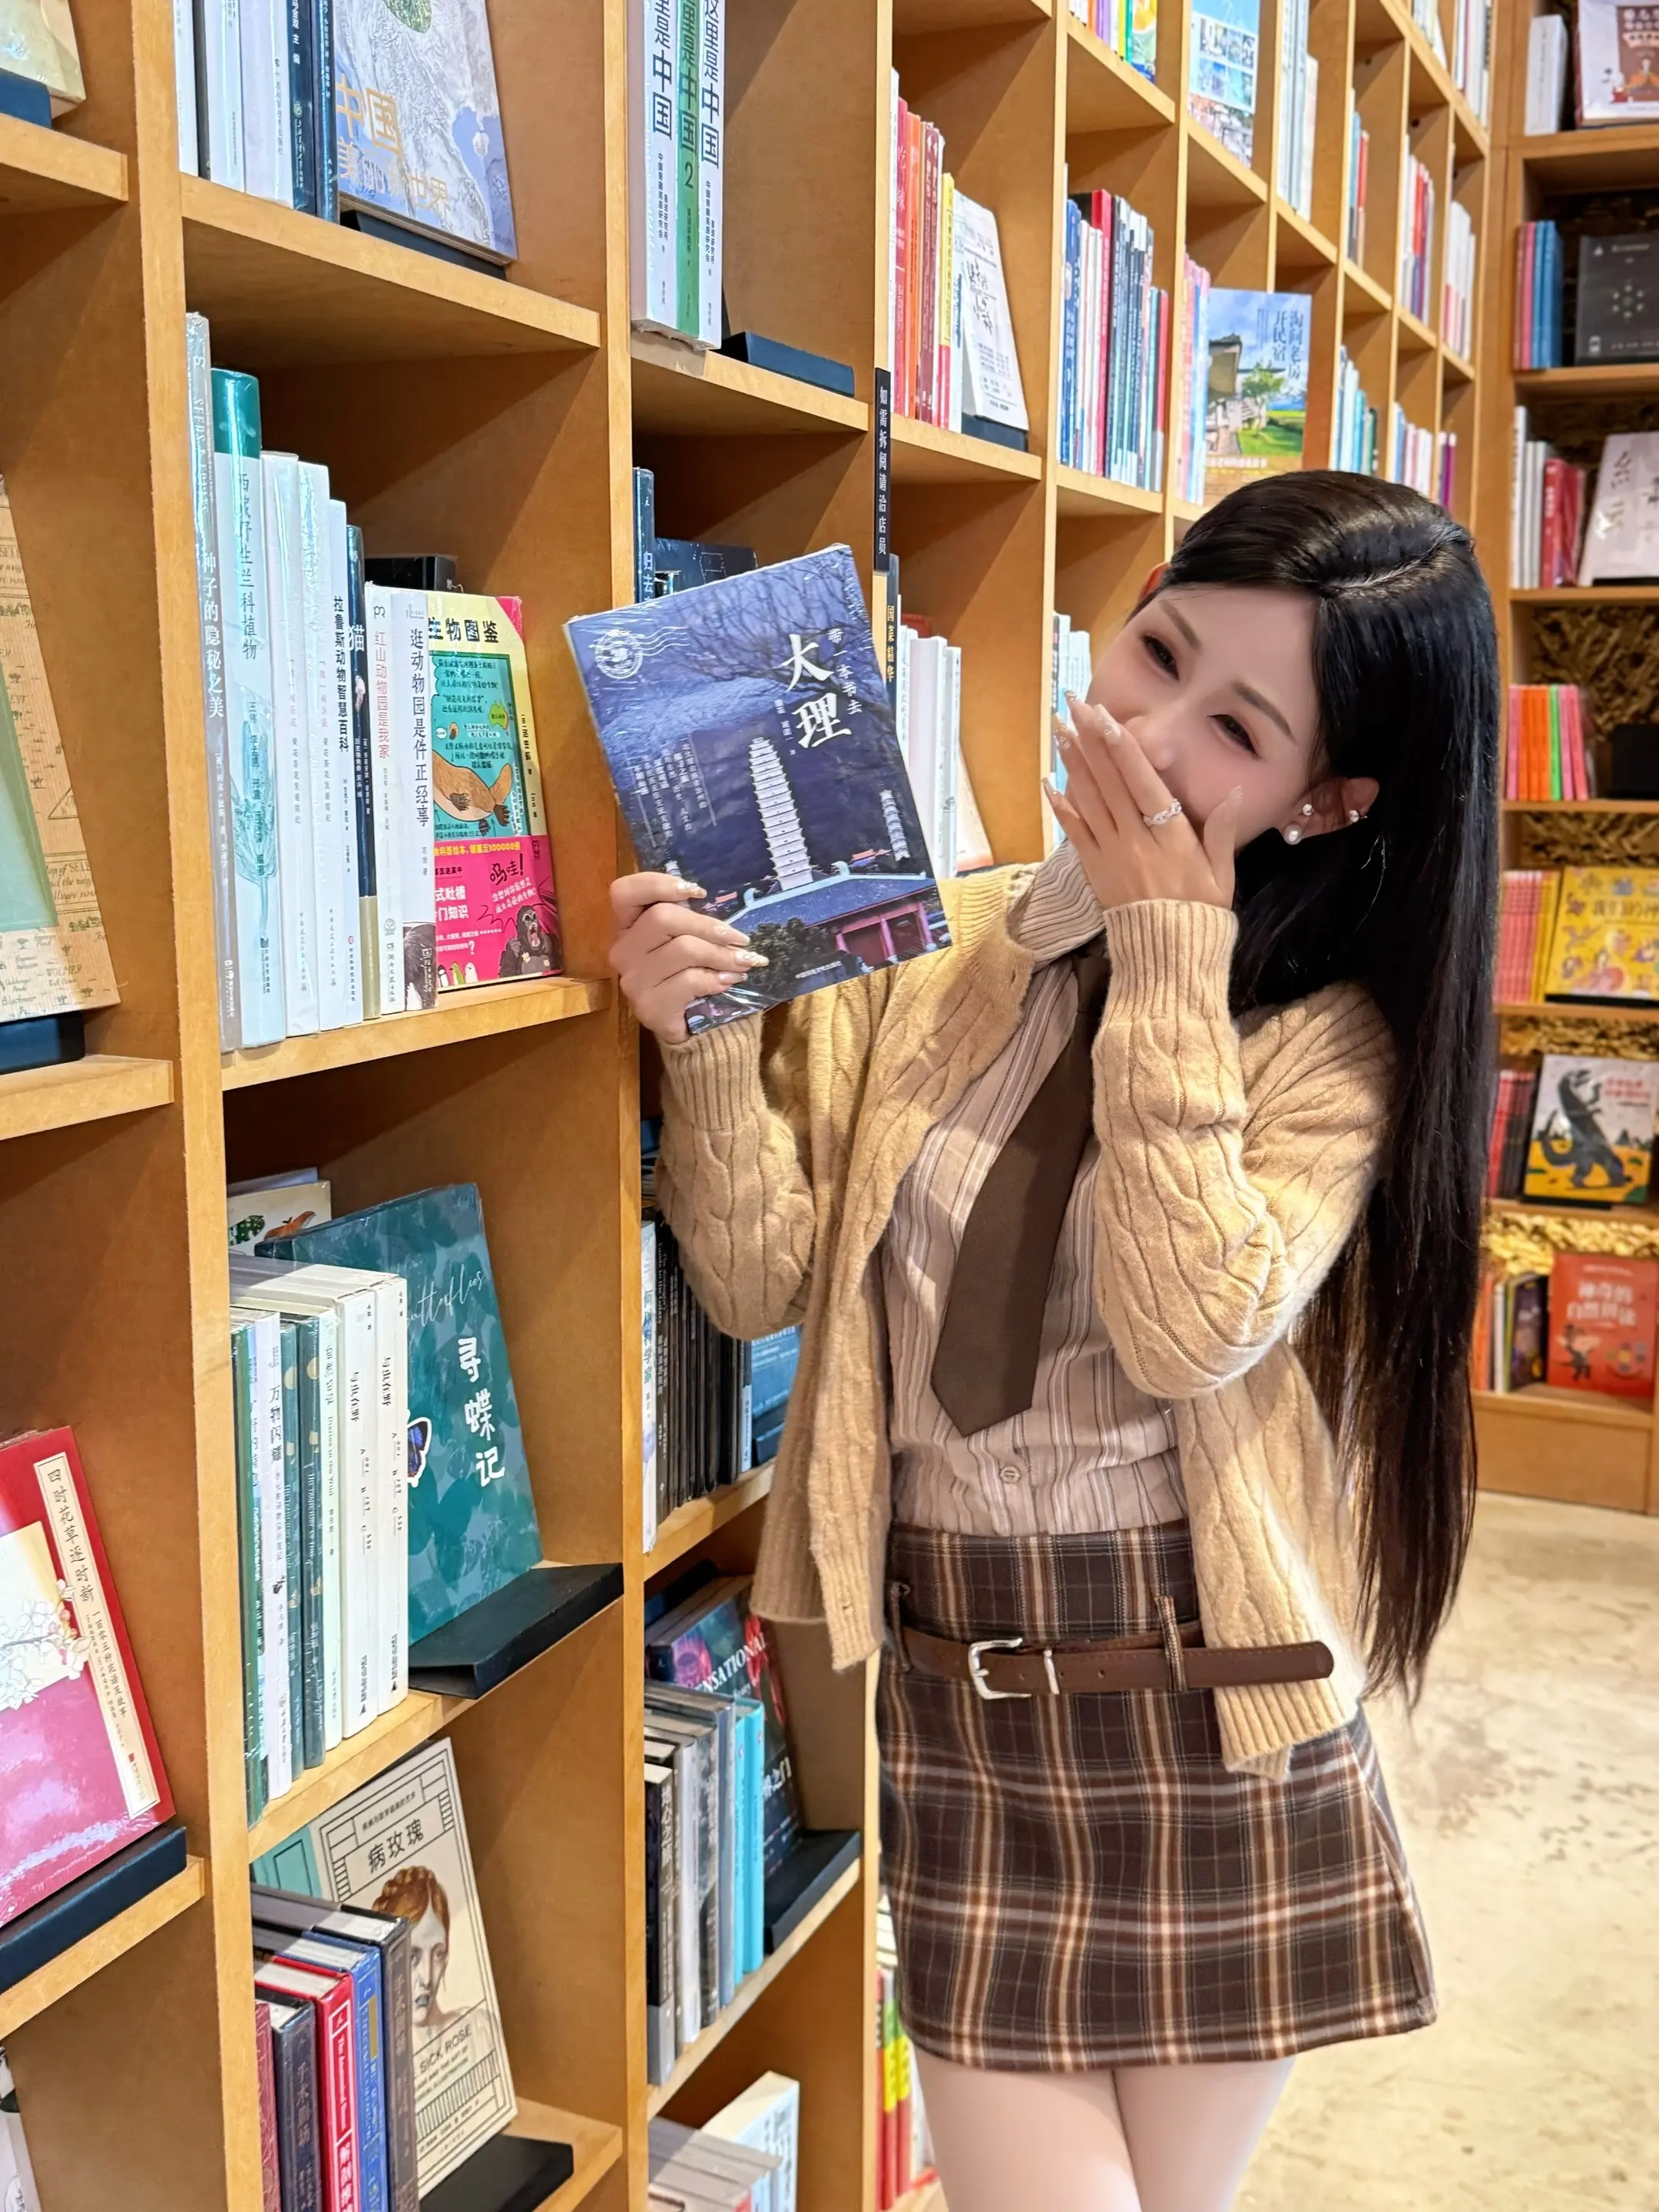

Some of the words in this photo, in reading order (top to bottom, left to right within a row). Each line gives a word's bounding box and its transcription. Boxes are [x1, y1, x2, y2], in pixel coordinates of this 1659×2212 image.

[335, 72, 405, 158] 中国
[201, 551, 224, 720] 种子的隐秘之美
[348, 624, 366, 653] 猫
[771, 633, 853, 749] 大理
[409, 628, 430, 827] 逛动物园是件正经事
[435, 885, 467, 902] 式吐槽
[435, 905, 469, 922] 门知识
[457, 1336, 507, 1488] 寻蝶记
[694, 1631, 767, 1693] ENSATIONAL
[368, 1818, 424, 1873] 病玫瑰
[419, 2049, 443, 2073] SICK
[445, 2024, 472, 2052] ROSE
